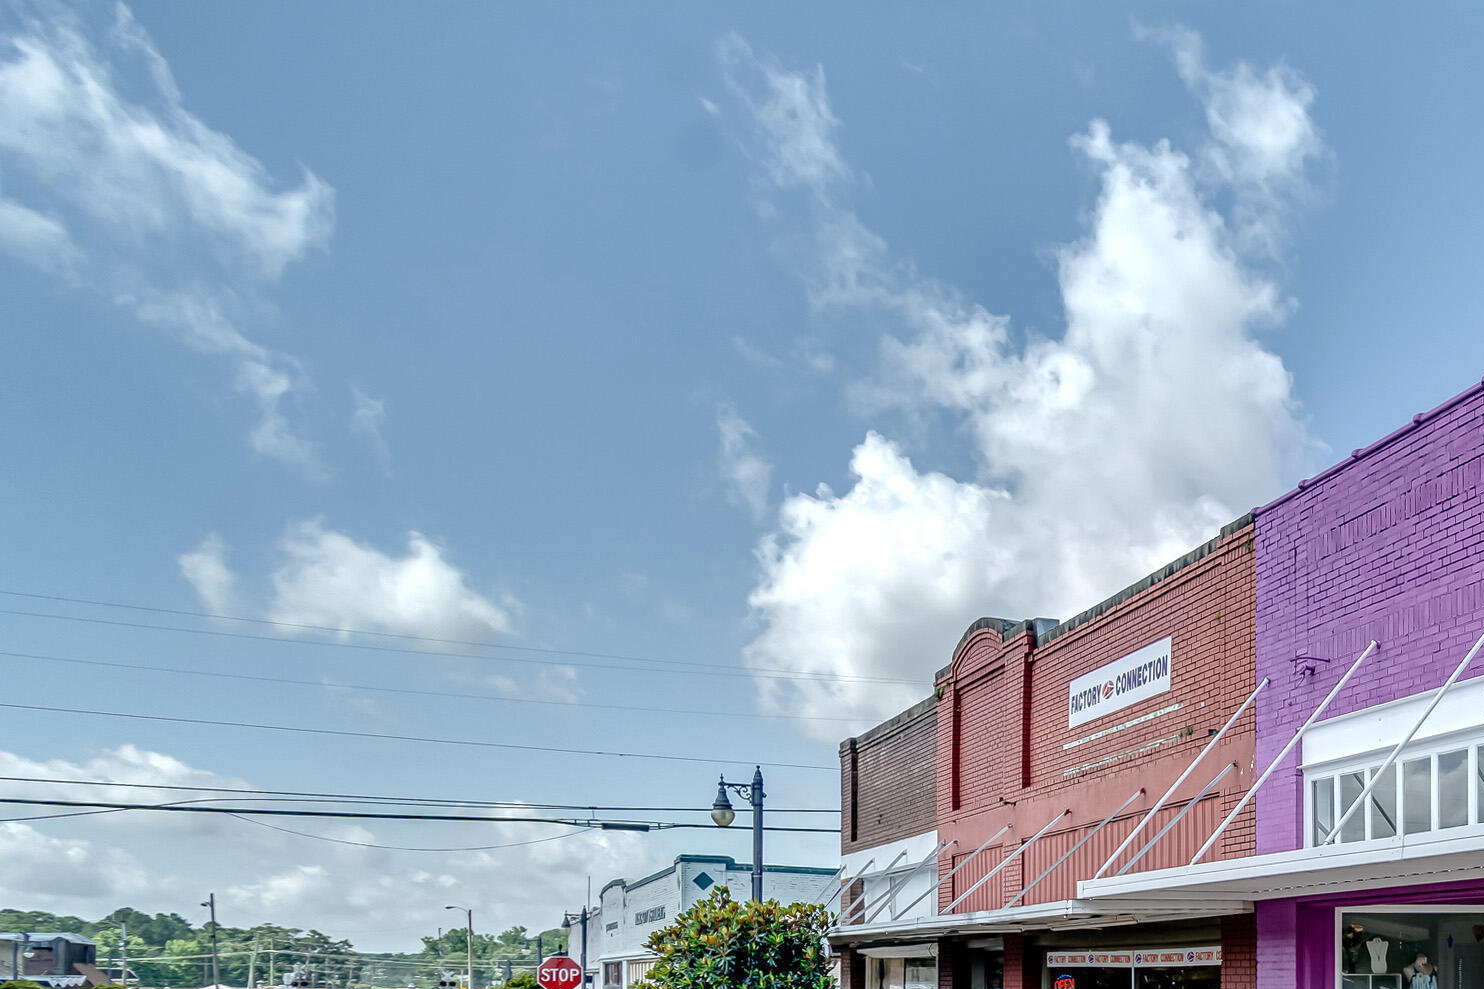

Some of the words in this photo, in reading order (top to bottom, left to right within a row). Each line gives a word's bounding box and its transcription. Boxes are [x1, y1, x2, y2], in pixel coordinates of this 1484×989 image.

[1070, 683, 1102, 715] FACTORY
[1115, 654, 1168, 696] CONNECTION
[1142, 953, 1159, 962] FACTORY
[1160, 952, 1184, 962] CONNECTION
[1195, 951, 1214, 961] FACTORY
[540, 968, 580, 982] STOP
